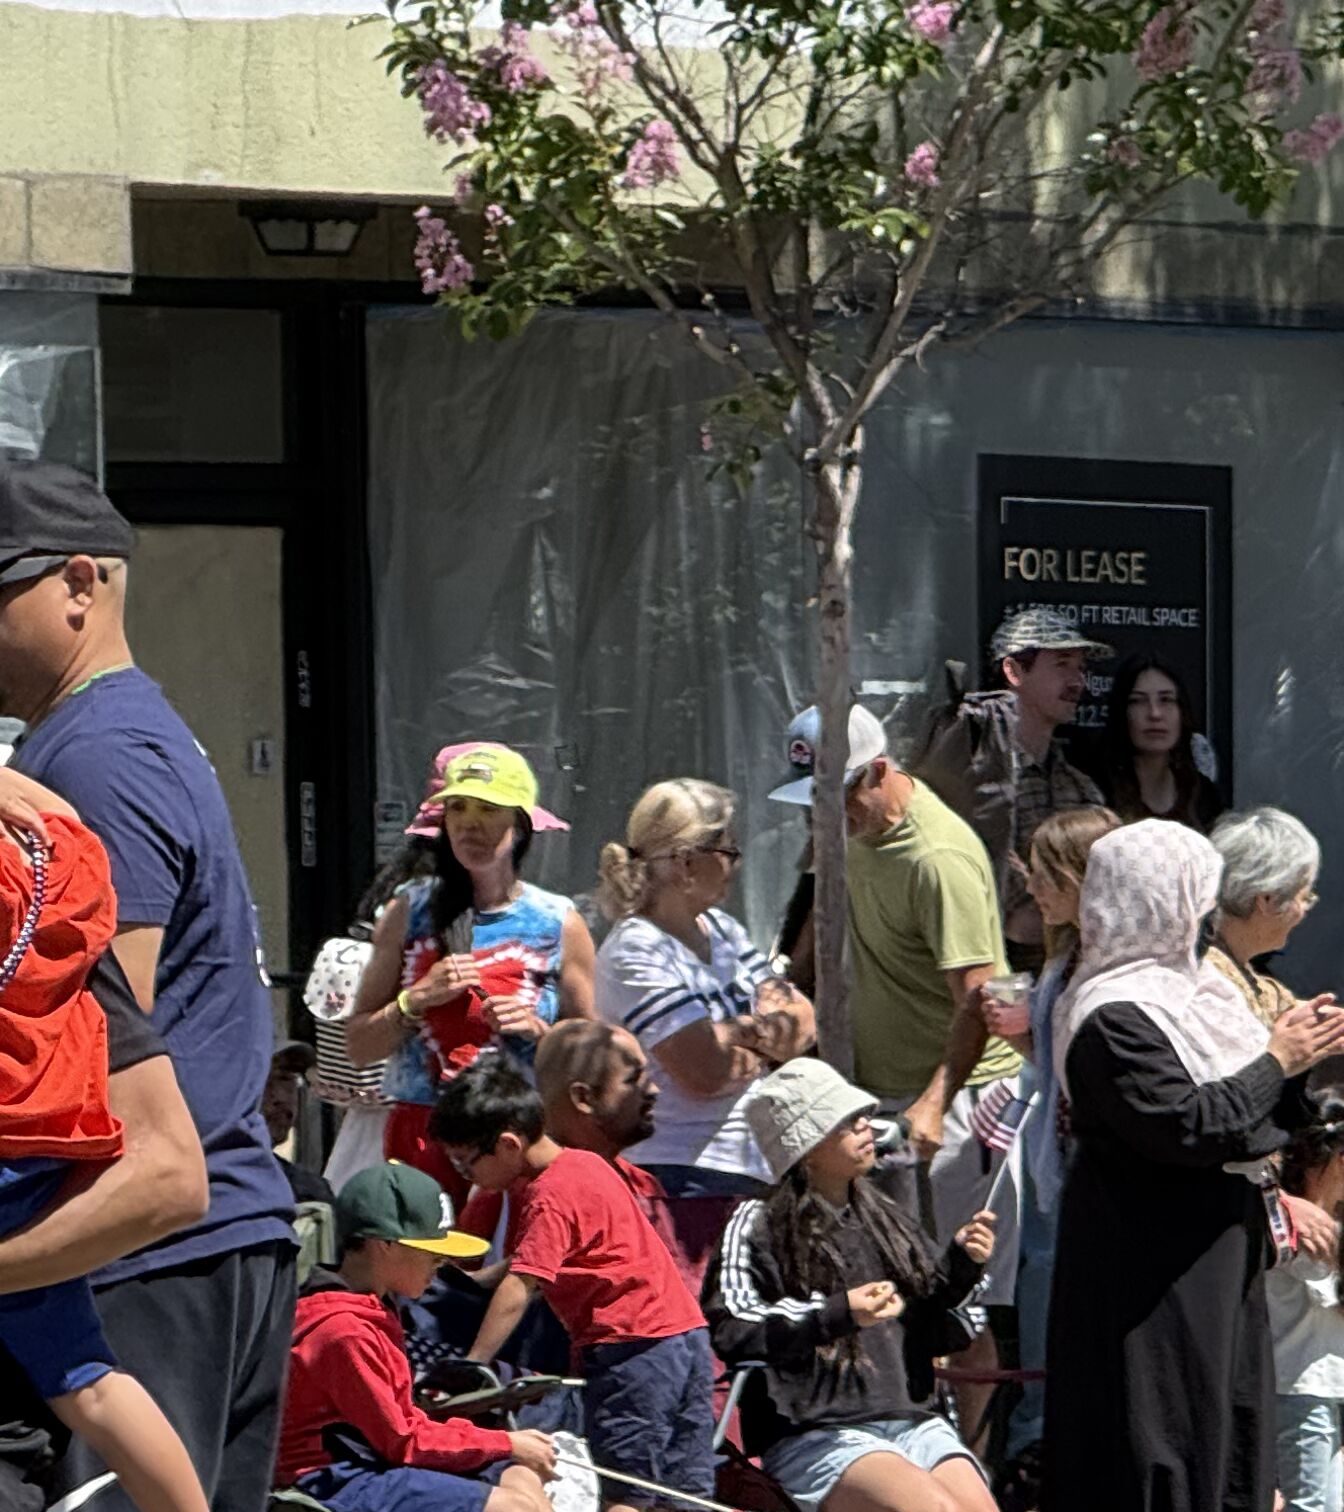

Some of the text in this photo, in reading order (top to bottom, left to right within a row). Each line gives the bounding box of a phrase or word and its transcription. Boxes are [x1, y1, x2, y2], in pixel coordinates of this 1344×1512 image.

[1003, 547, 1148, 586] FOR LEASE
[1081, 604, 1100, 625] FT
[1101, 605, 1152, 627] RETAIL
[1151, 607, 1200, 628] SPACE
